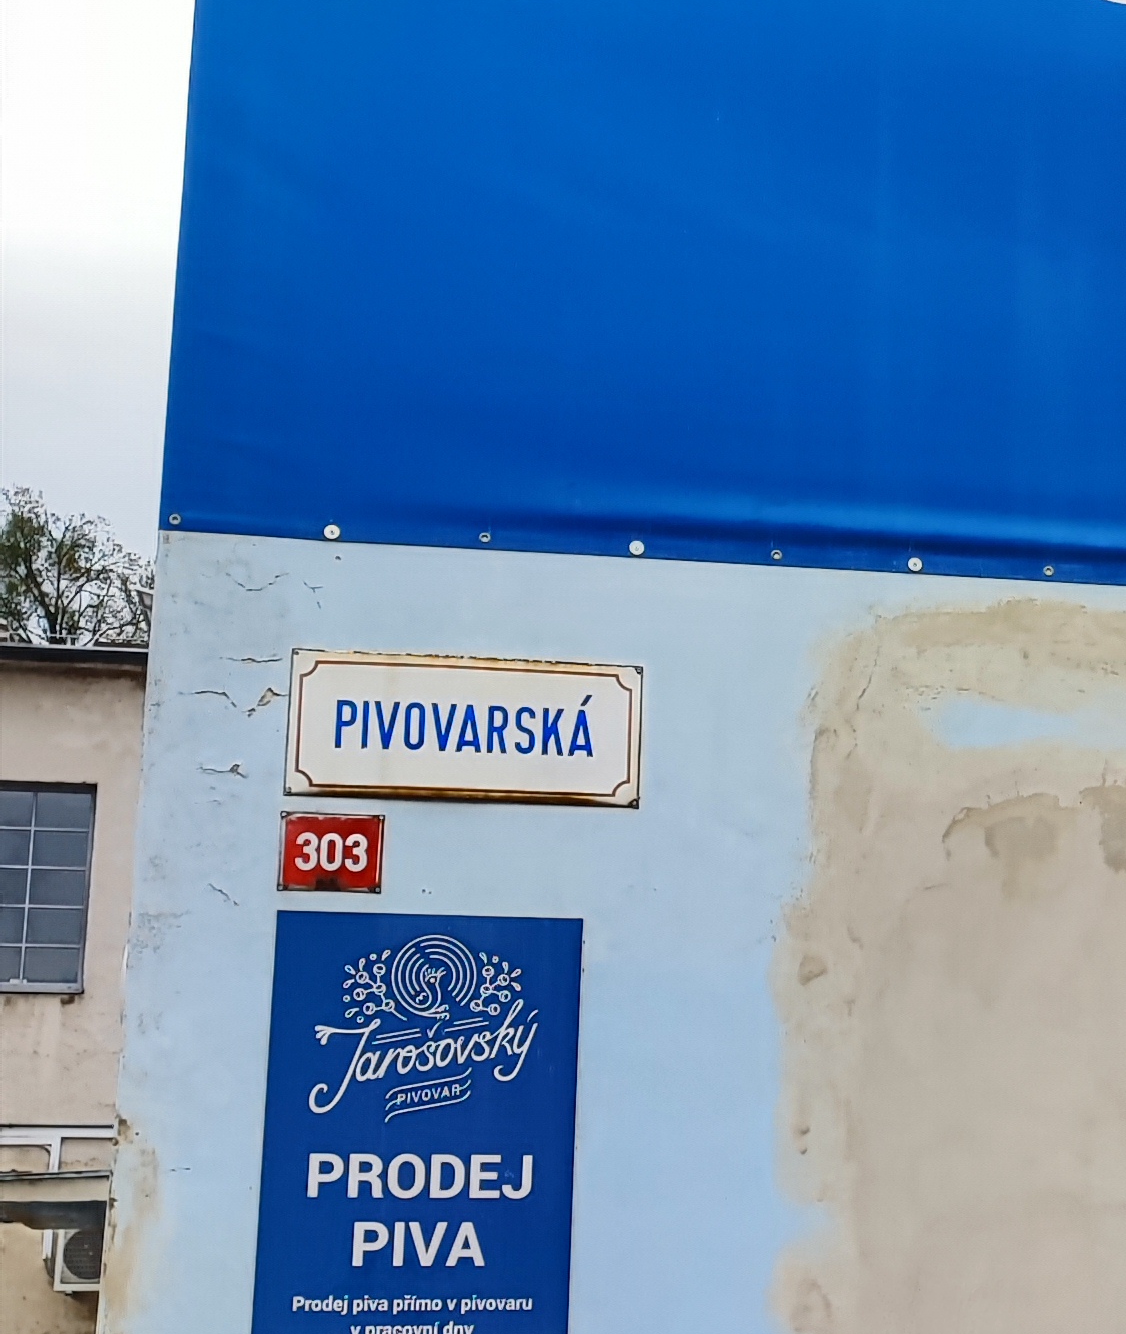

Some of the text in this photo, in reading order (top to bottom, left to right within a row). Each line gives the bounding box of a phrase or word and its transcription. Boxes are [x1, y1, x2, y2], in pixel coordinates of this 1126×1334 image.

[334, 695, 594, 757] PIVOVARSKÁ
[295, 832, 368, 872] 303
[308, 998, 539, 1114] Jarošovský
[397, 1083, 461, 1105] PIVOVAR
[306, 1153, 534, 1199] PRODEJ
[351, 1221, 485, 1267] PIVA
[292, 1295, 533, 1315] Prodej piva přímo v pivovaru
